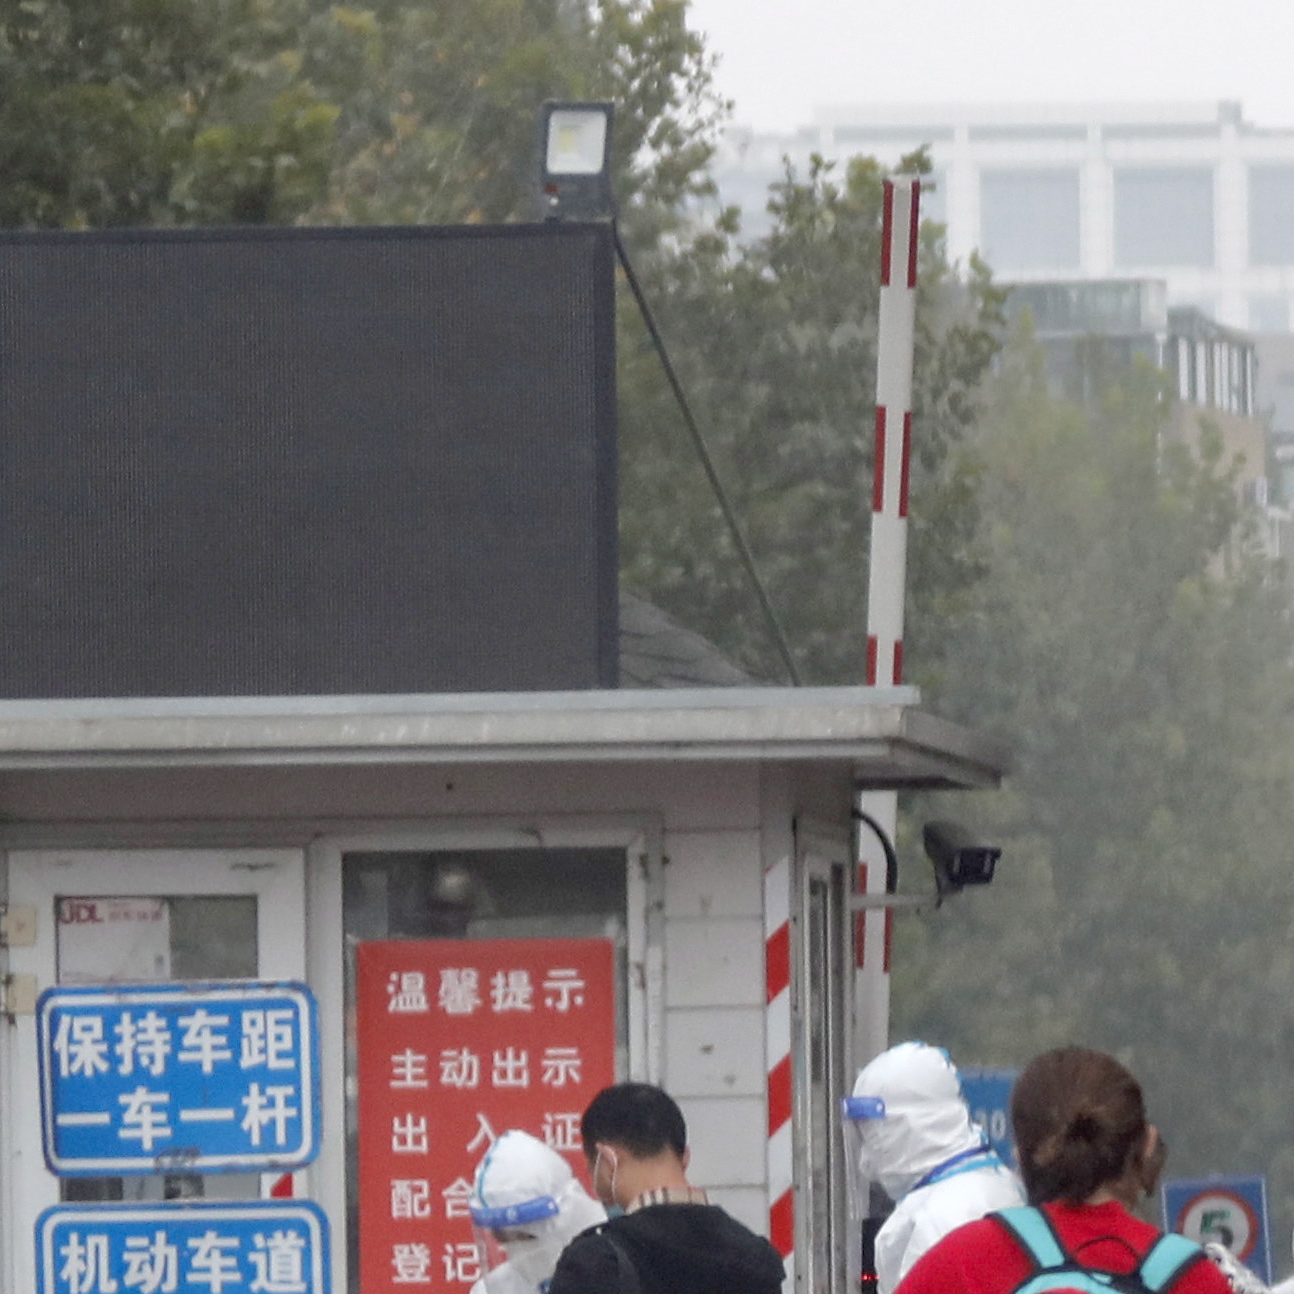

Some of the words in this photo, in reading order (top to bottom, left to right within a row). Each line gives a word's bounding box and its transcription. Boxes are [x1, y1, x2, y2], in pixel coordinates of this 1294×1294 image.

[386, 968, 585, 1014] 温馨提示
[53, 1009, 296, 1077] 保持车距
[389, 1047, 582, 1089] 主动出示
[56, 1082, 298, 1151] 一车一杆
[1200, 1210, 1234, 1250] 5
[59, 1230, 307, 1294] 机动车道
[391, 1242, 483, 1283] 登记
